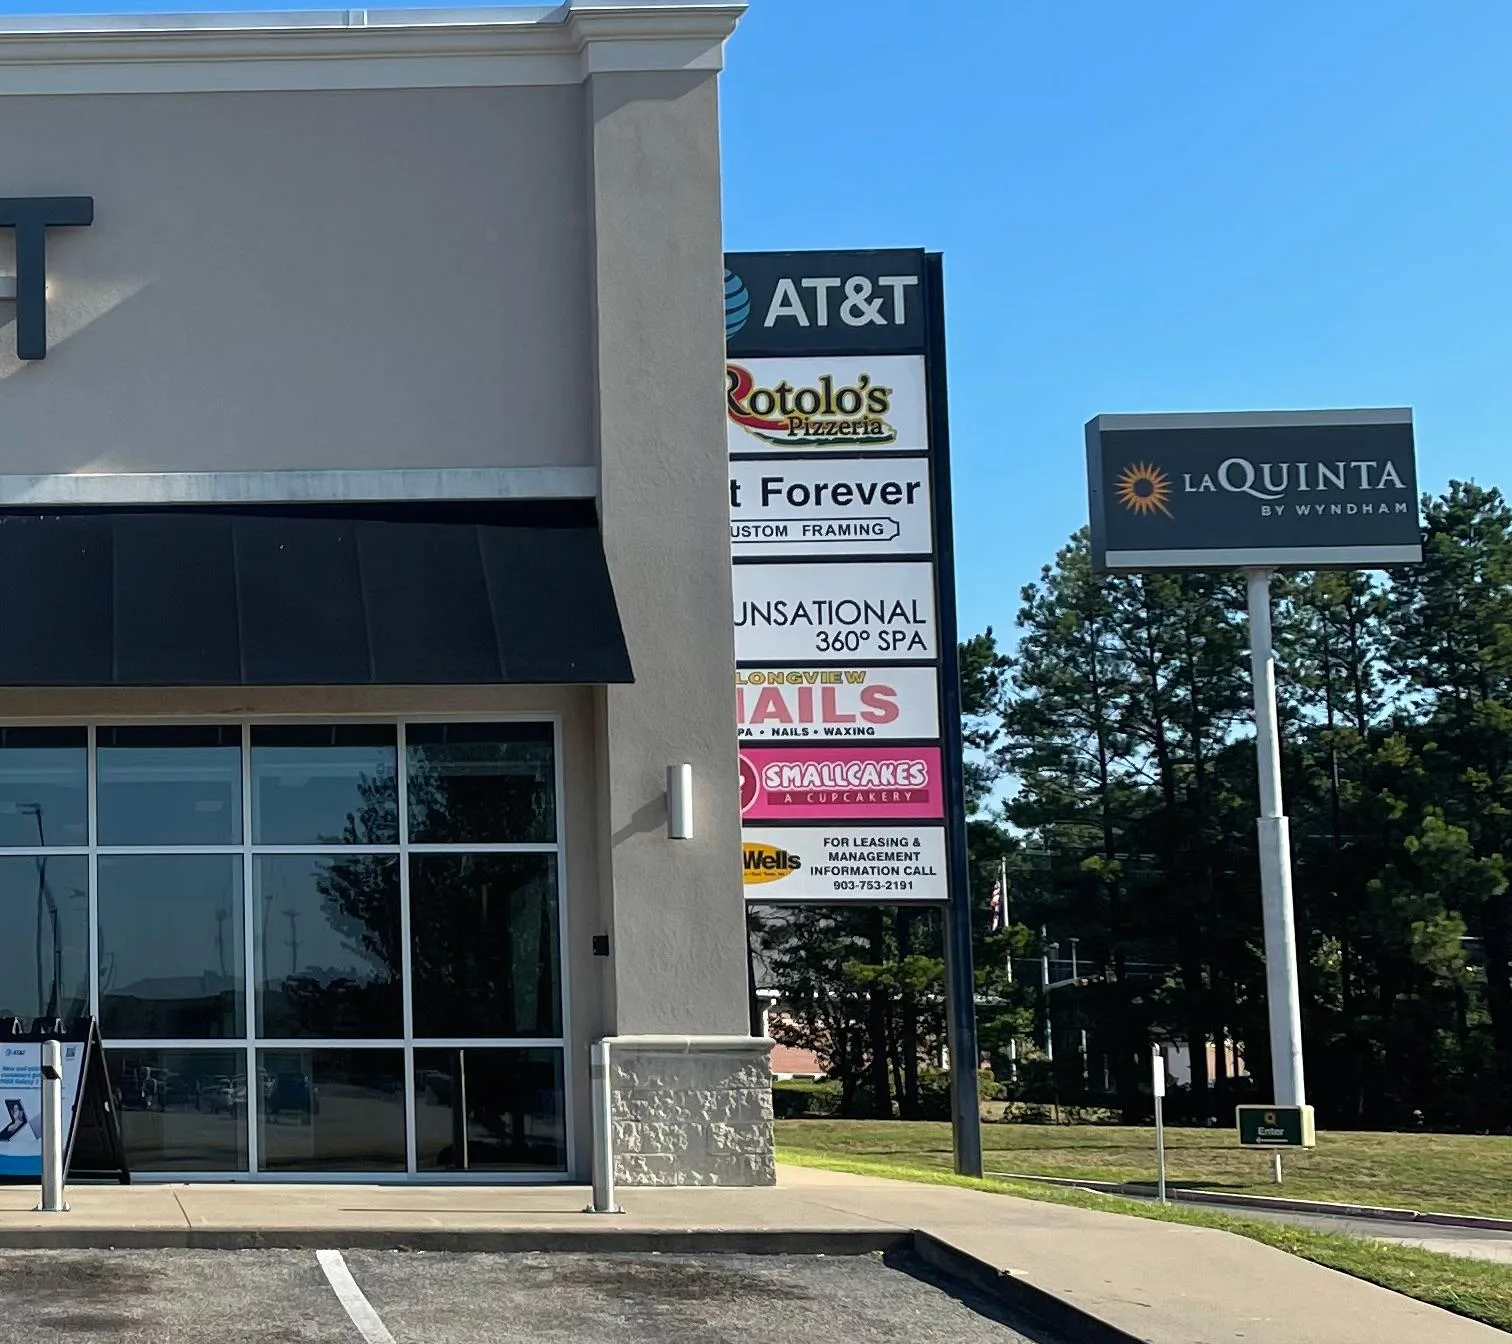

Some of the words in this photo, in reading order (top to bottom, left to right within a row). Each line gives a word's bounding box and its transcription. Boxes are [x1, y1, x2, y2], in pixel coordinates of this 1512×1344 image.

[764, 275, 918, 328] AT&T
[787, 415, 884, 436] Pizzeria
[761, 477, 921, 507] Forever
[1261, 504, 1285, 517] BY
[1295, 502, 1408, 516] WYNDHAM
[730, 524, 789, 538] USTOM
[802, 522, 885, 537] FRAMING
[733, 599, 927, 627] UNSATIONAL
[877, 629, 928, 652] SPA
[736, 670, 867, 685] LONGVIEW
[737, 727, 753, 737] PA
[772, 727, 809, 737] NAILS
[823, 726, 876, 736] WAXING
[764, 761, 928, 789] SMALLCAKES
[784, 793, 792, 803] A
[807, 791, 913, 803] CUPCAKERY
[823, 837, 849, 848] FOR
[853, 837, 909, 848] LEASING
[912, 837, 921, 848] &
[743, 850, 802, 870] Wells
[828, 851, 921, 862] MANAGEMENT
[810, 866, 900, 877] INFORMATION
[903, 865, 937, 876] CALL
[833, 880, 913, 891] 903-753-2191
[1257, 1126, 1285, 1136] Enter
